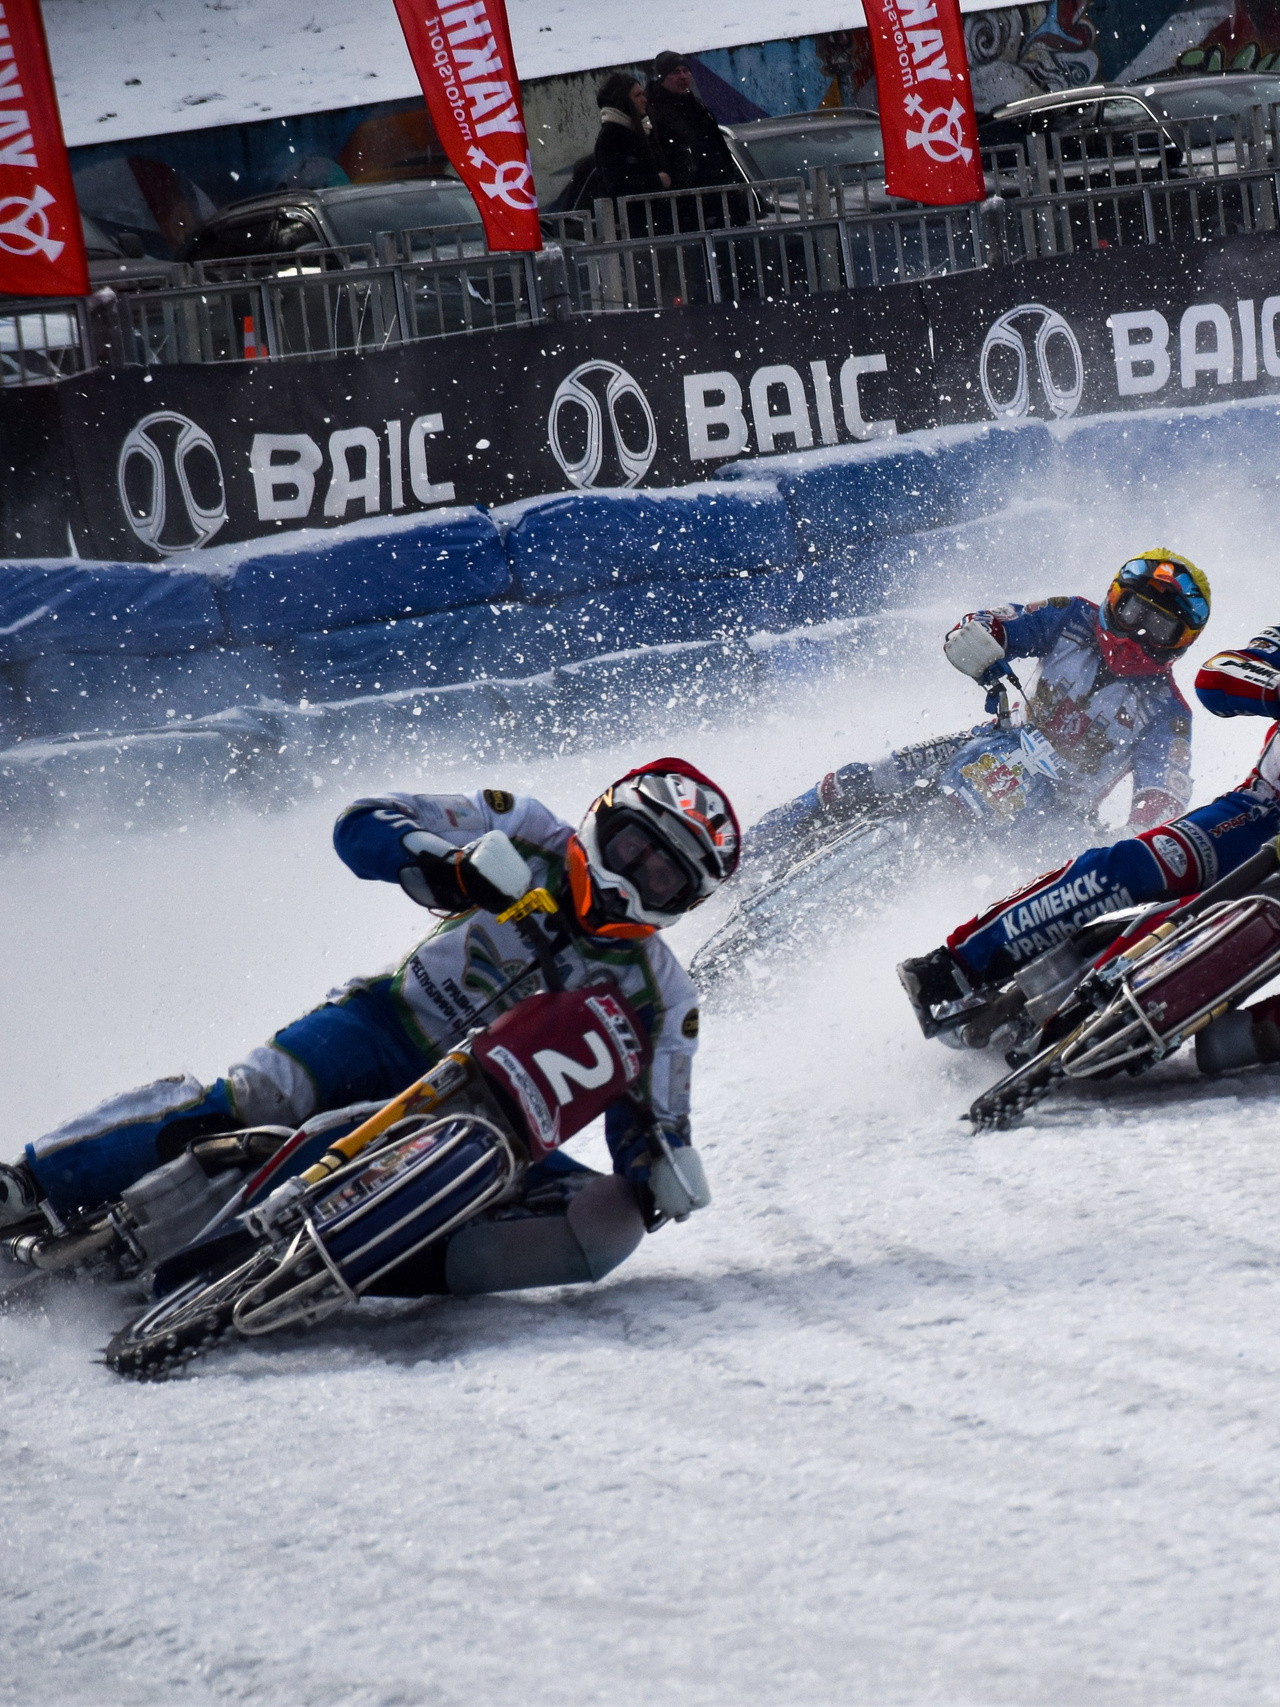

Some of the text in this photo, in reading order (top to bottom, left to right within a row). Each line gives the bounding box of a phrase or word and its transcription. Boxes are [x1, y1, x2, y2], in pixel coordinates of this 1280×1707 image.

[683, 353, 897, 460] BAIC
[250, 413, 456, 521] BAIC
[1002, 870, 1108, 940] КАМЕНСК-
[532, 1030, 614, 1107] 2
